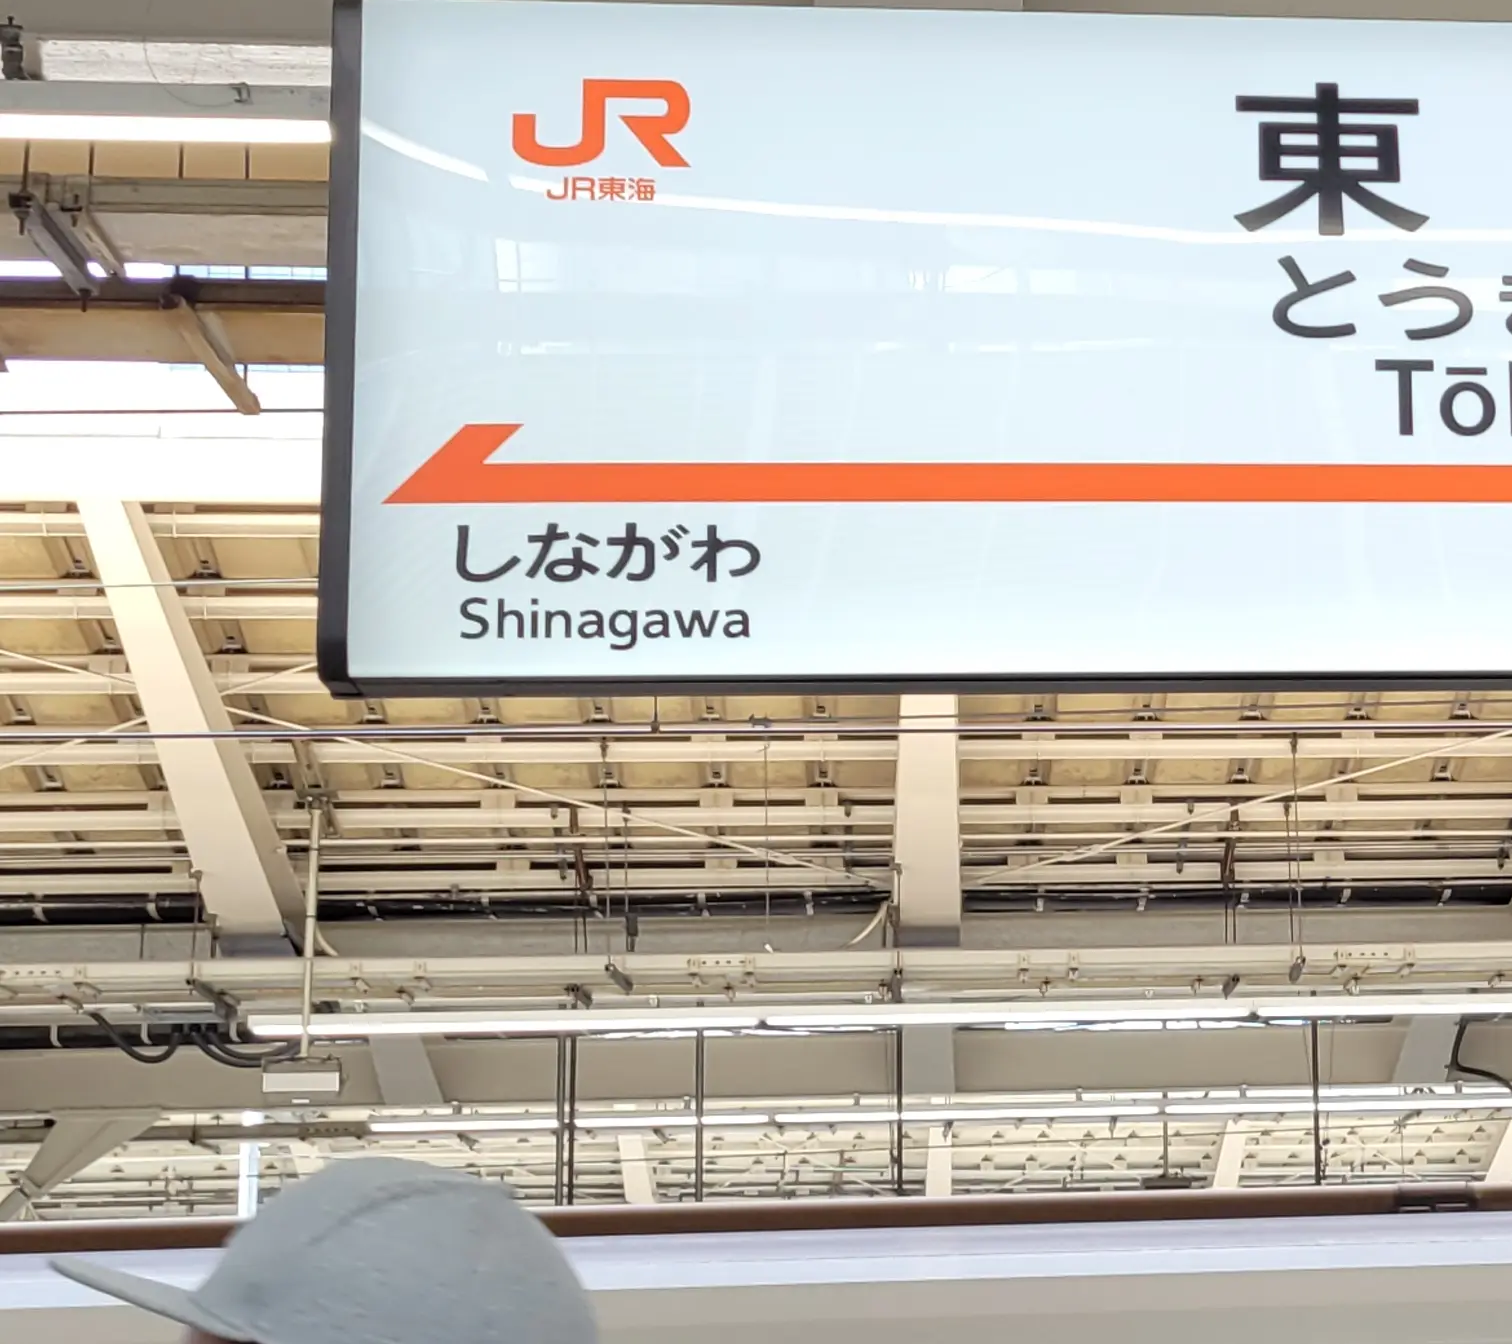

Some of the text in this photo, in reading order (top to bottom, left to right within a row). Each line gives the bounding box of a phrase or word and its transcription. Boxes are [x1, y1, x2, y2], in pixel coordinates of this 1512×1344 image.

[511, 78, 691, 167] JR
[546, 176, 656, 202] JR東海
[455, 522, 761, 583] しながわ
[459, 596, 750, 651] Shinagawa
